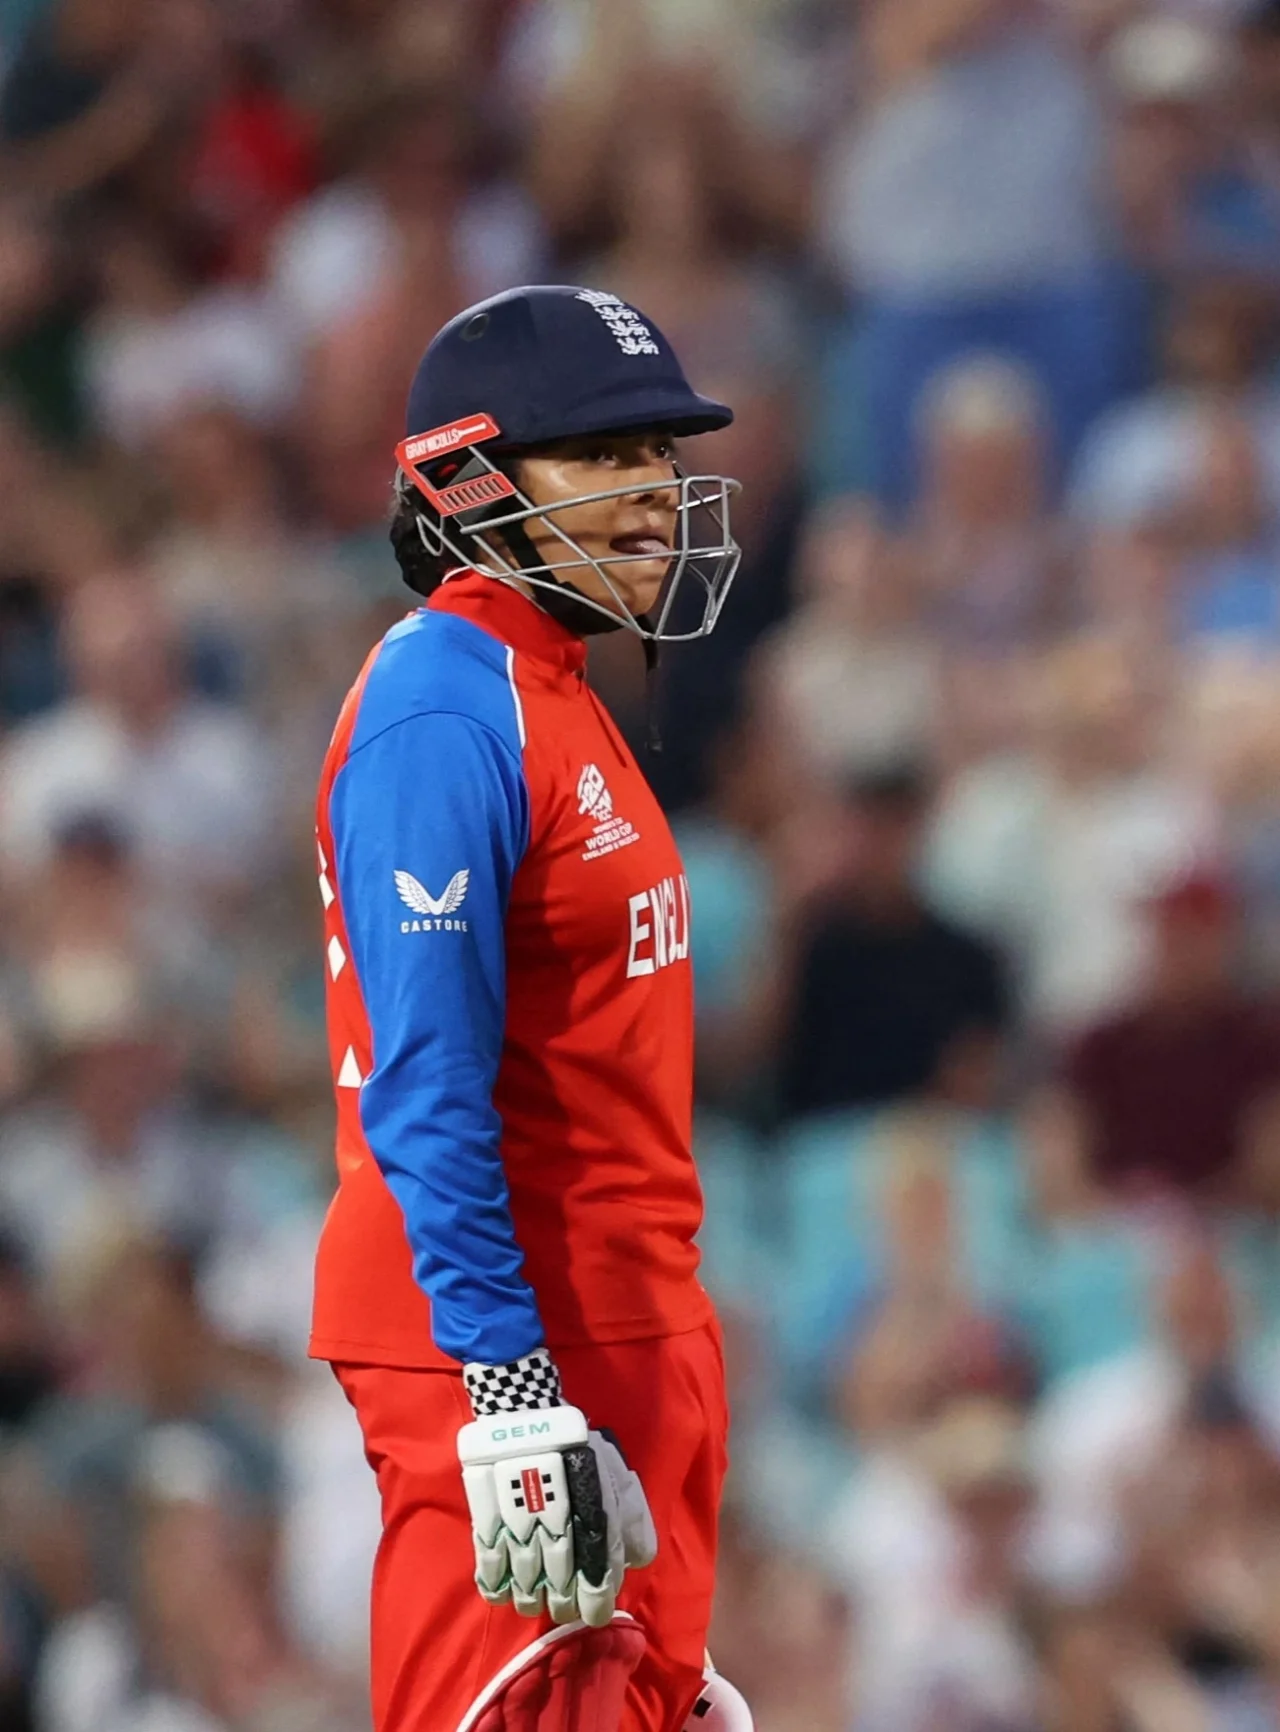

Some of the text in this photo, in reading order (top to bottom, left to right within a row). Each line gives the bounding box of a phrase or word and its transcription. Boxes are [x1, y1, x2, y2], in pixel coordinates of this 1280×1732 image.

[585, 828, 620, 851] WORLD
[400, 919, 468, 934] CASTORE
[491, 1422, 550, 1442] GEM
